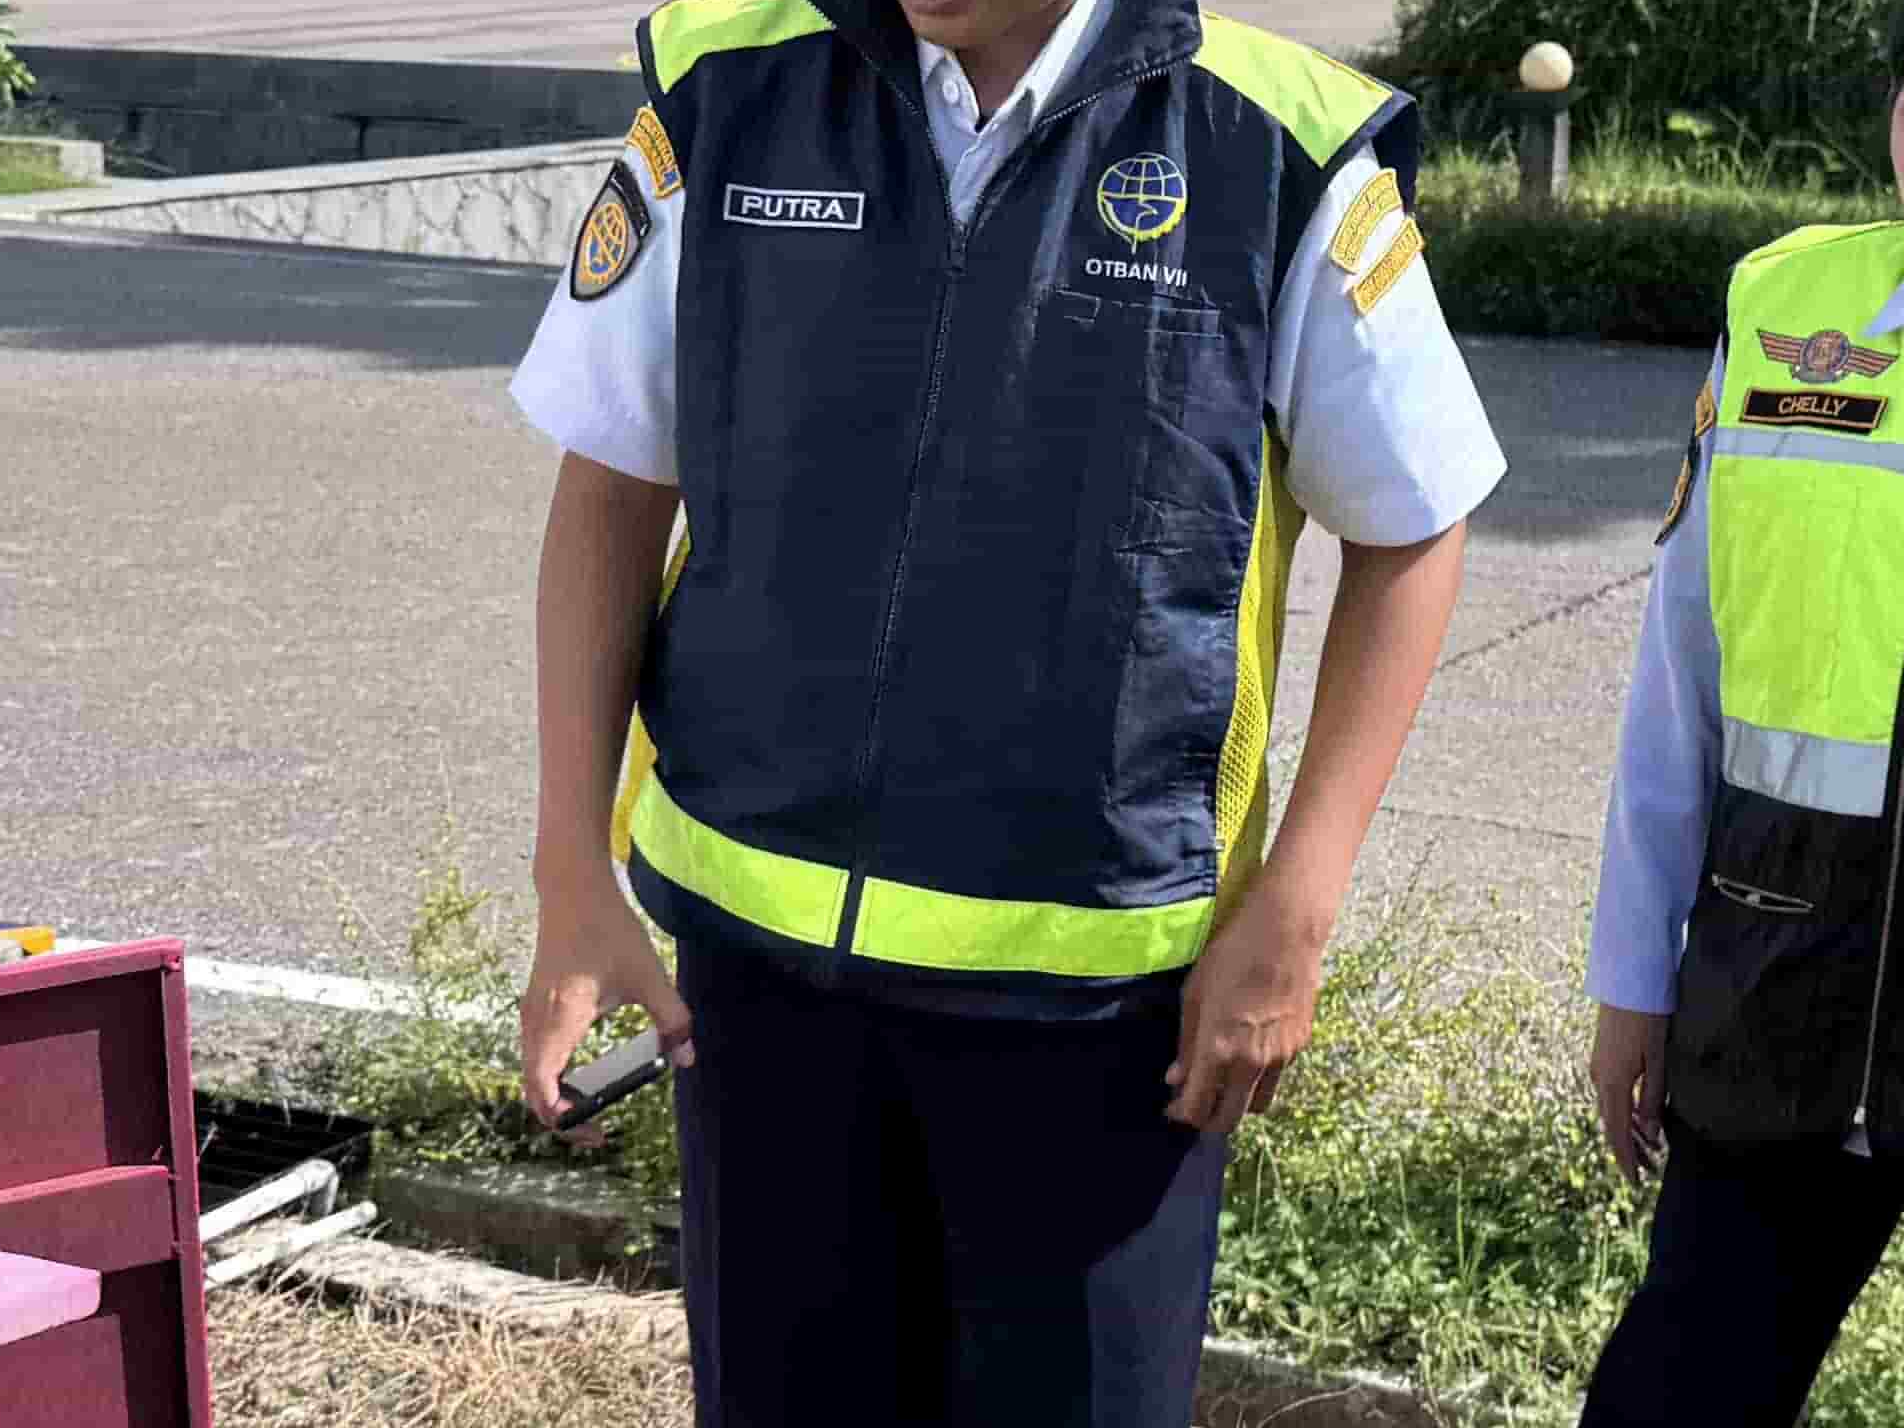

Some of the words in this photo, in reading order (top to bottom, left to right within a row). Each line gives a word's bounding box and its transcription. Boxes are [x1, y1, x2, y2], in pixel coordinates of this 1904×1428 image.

[741, 194, 845, 221] PUTRA
[1085, 258, 1158, 282] OTBAN
[1163, 265, 1188, 288] VII
[1778, 395, 1848, 416] CHELLY
